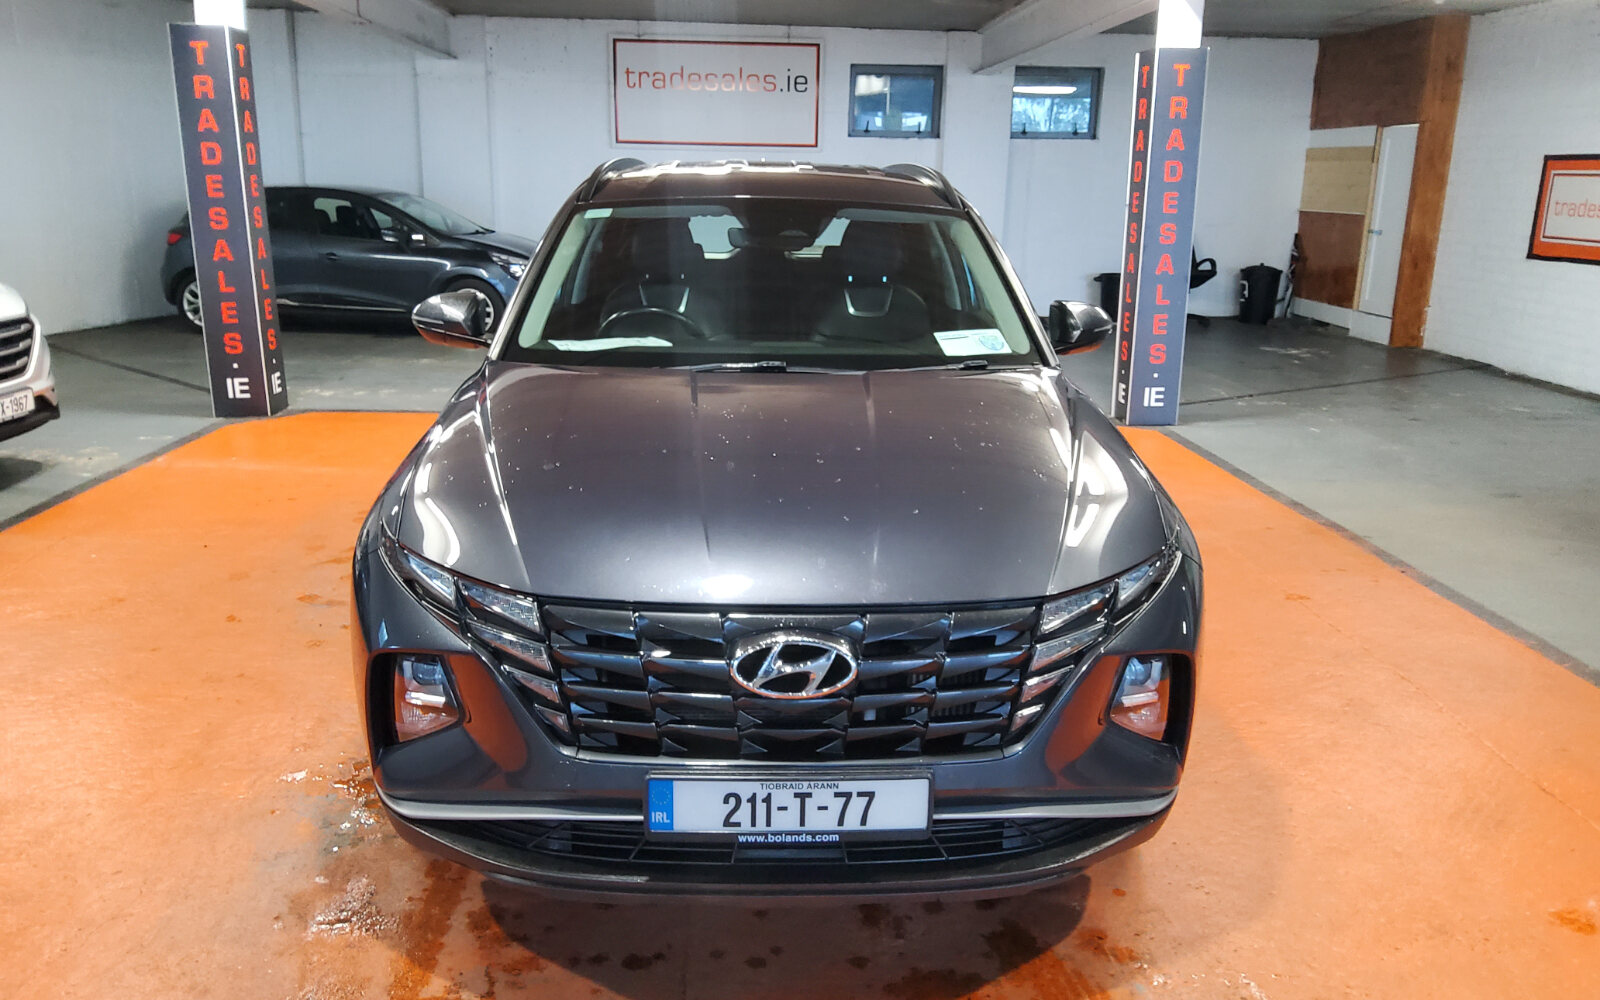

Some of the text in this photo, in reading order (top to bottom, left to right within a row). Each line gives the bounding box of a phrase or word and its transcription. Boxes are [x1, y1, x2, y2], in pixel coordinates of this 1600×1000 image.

[624, 65, 809, 93] tradesales.ie
[651, 811, 671, 823] IRL
[722, 791, 876, 828] 211-T-77
[737, 833, 840, 843] www.bolands.com
